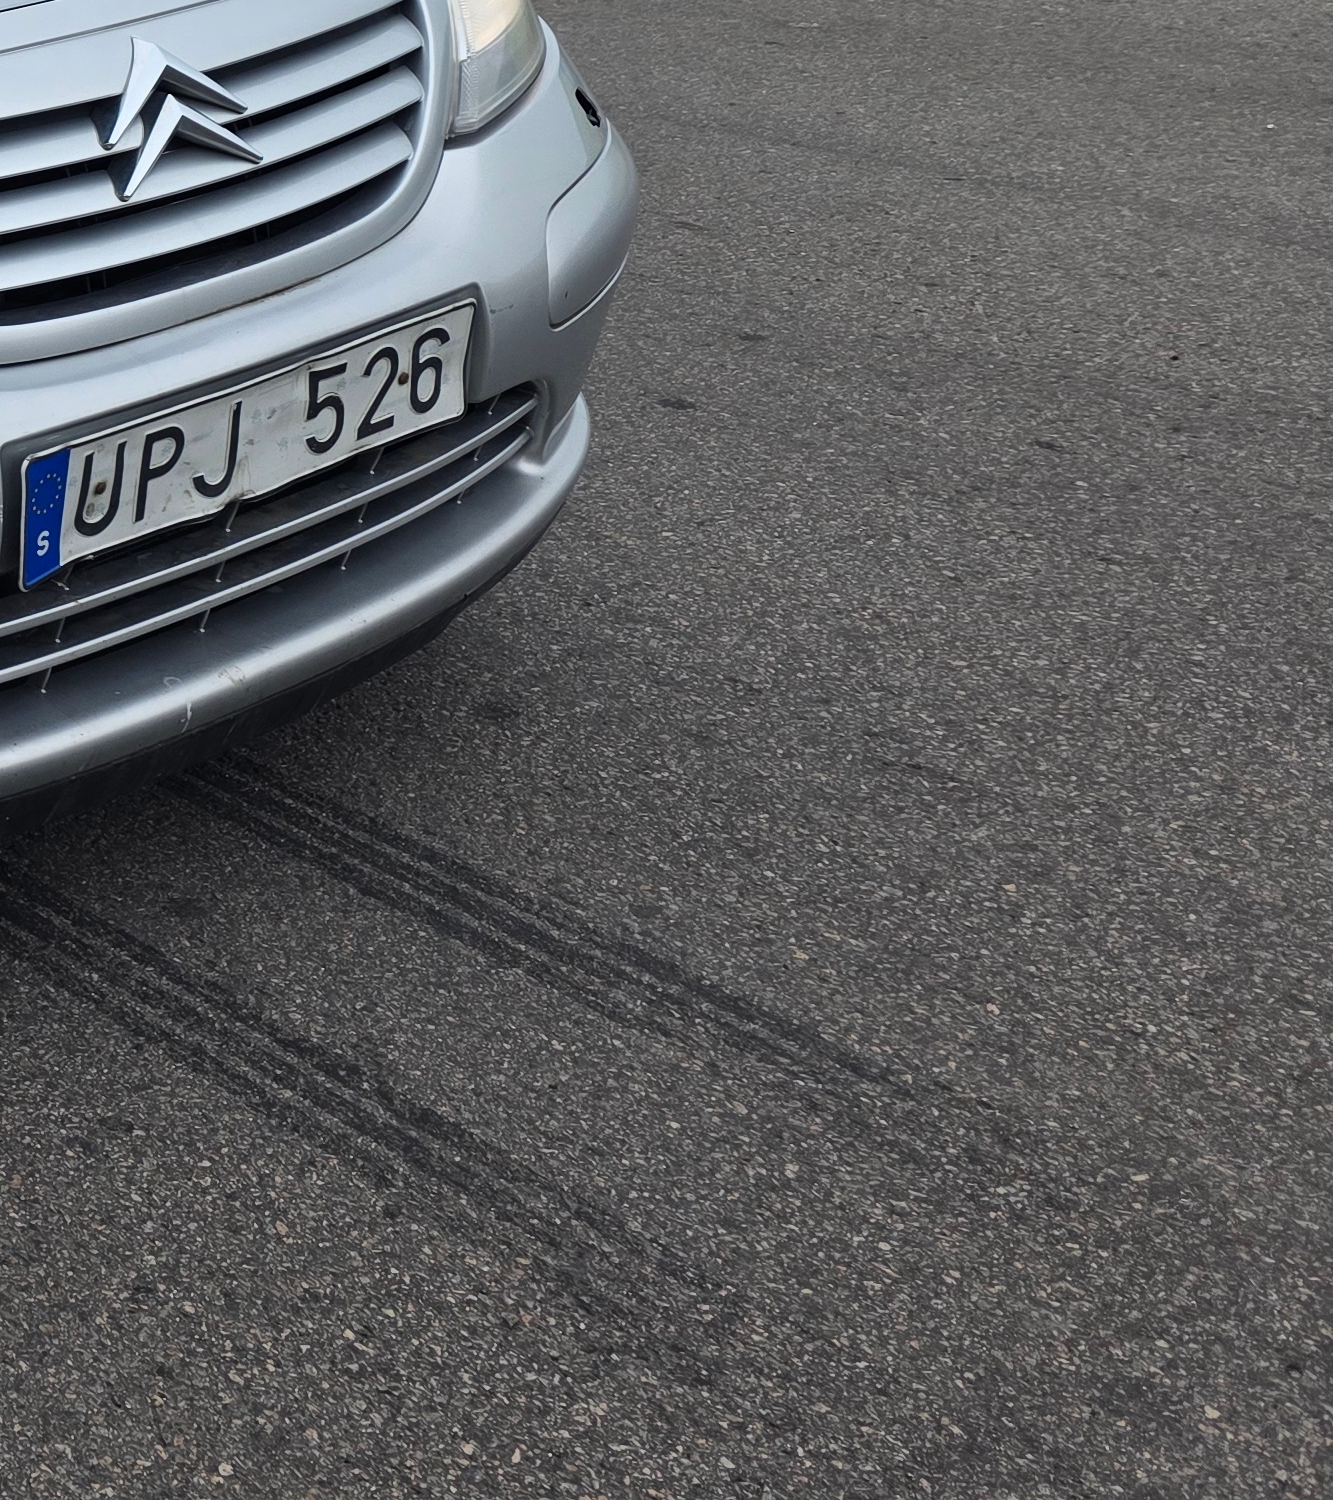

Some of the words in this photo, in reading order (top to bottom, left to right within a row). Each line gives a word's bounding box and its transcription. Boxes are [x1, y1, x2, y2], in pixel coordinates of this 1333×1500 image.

[73, 400, 243, 537] UPJ
[304, 327, 452, 455] 526
[35, 529, 51, 557] S
